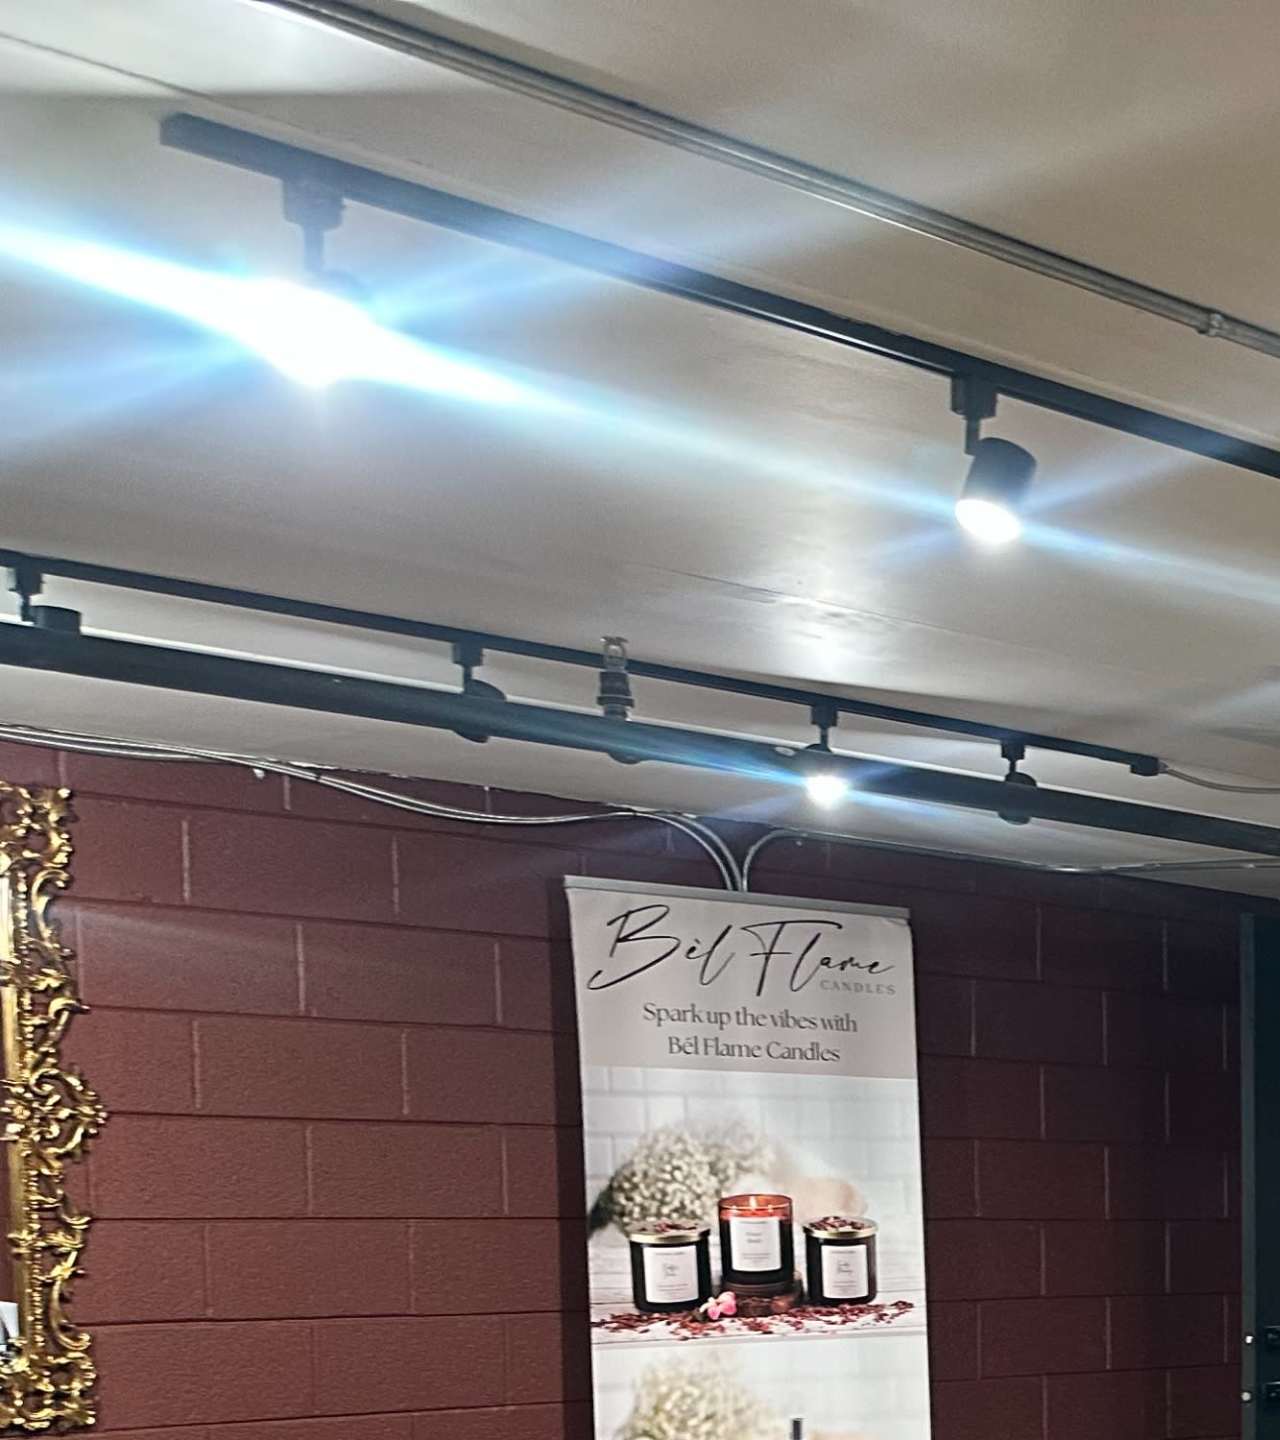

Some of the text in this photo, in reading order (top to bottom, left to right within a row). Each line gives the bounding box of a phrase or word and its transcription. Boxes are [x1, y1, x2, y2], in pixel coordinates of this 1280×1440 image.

[741, 919, 895, 997] Flame
[819, 979, 897, 996] CANDLES
[642, 1002, 858, 1032] Spark up the vibes with
[703, 1036, 762, 1058] Flame
[766, 1041, 841, 1061] Candles
